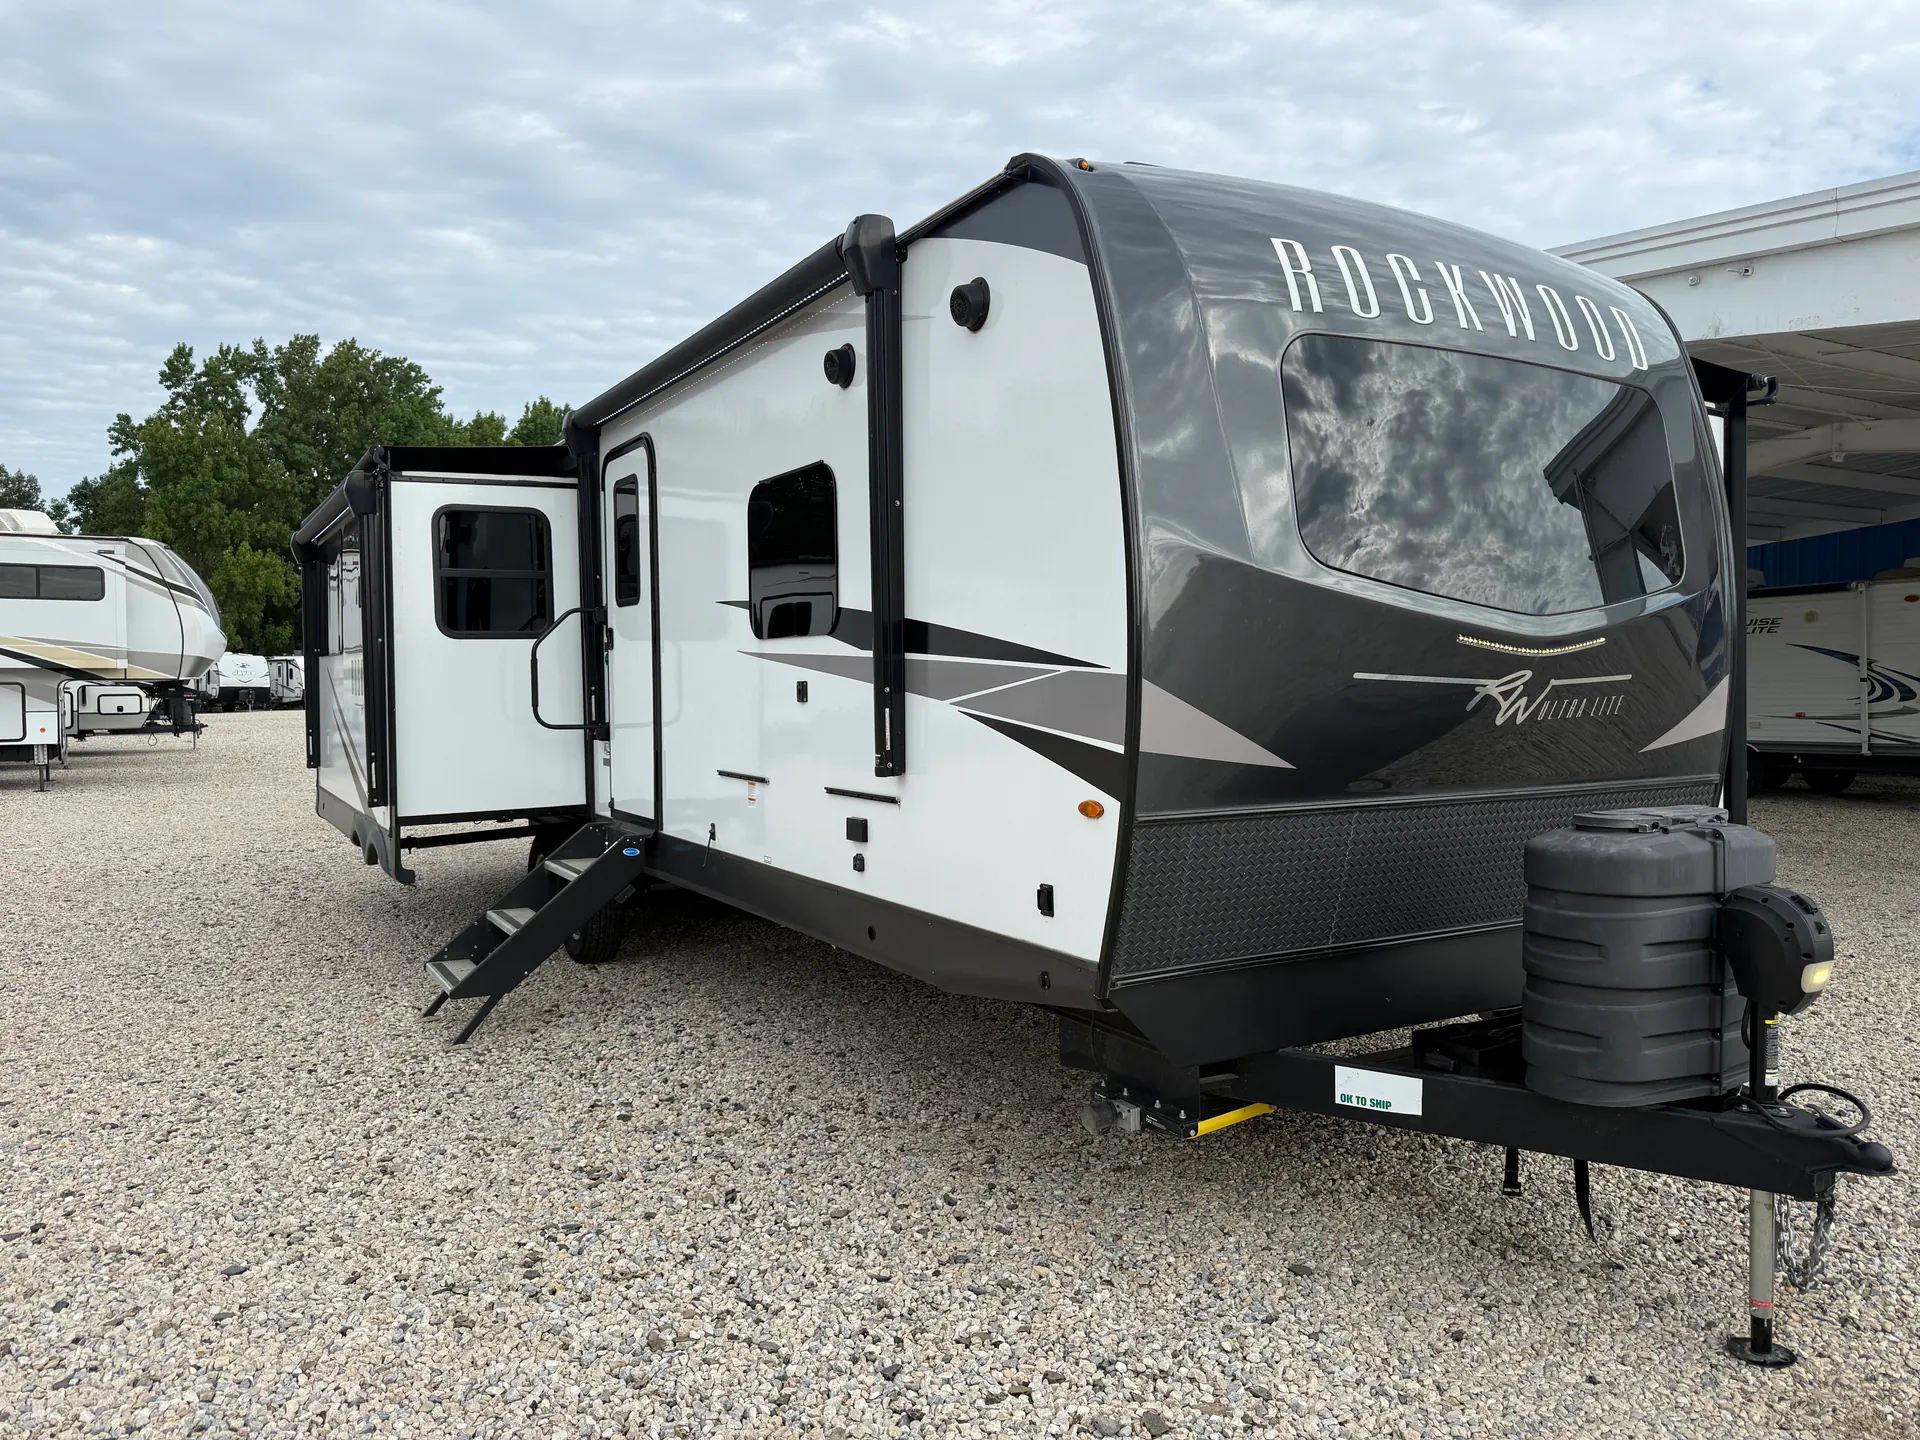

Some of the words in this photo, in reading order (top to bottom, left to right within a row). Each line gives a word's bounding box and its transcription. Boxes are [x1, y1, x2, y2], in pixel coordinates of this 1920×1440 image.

[1269, 237, 1649, 371] ROCKWOOD
[1537, 698, 1587, 720] ULTRA
[1590, 694, 1625, 717] LITE
[1340, 1093, 1353, 1104] OK
[1355, 1096, 1367, 1106] TO
[1369, 1098, 1392, 1110] SHIP
